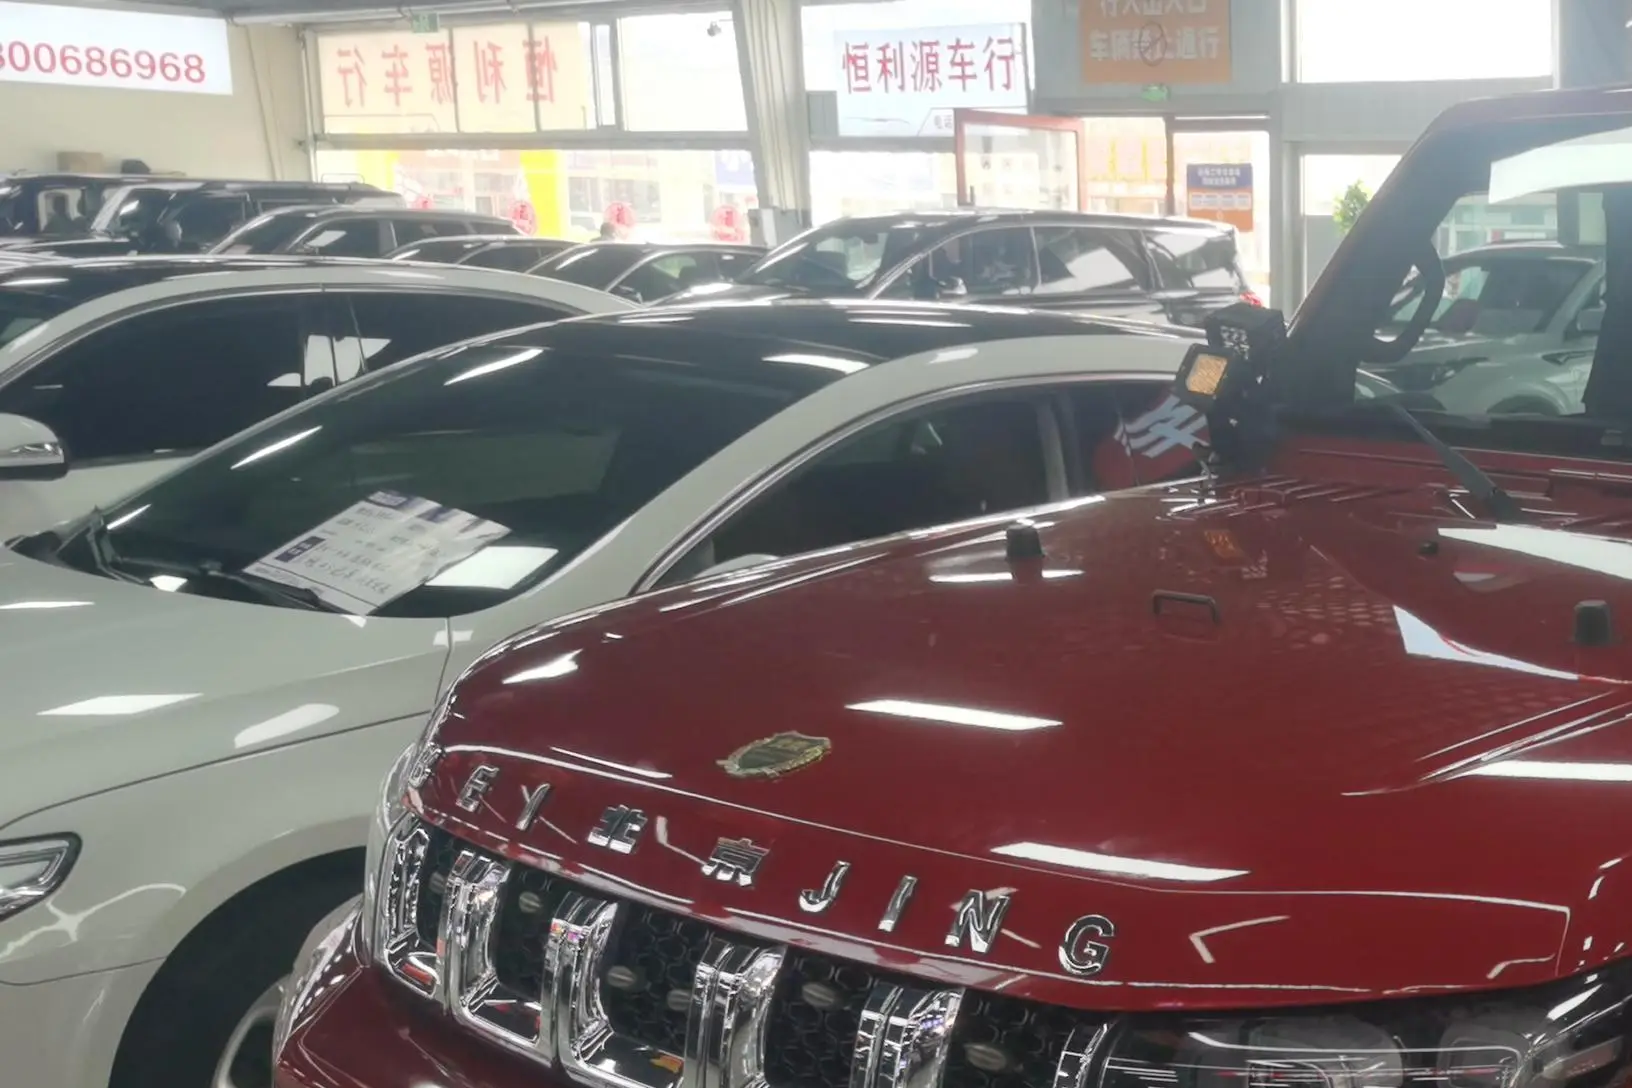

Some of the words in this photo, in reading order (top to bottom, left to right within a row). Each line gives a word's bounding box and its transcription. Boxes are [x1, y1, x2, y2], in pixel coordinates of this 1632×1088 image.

[842, 35, 1015, 94] 恒利源车行
[799, 859, 1115, 974] JING
